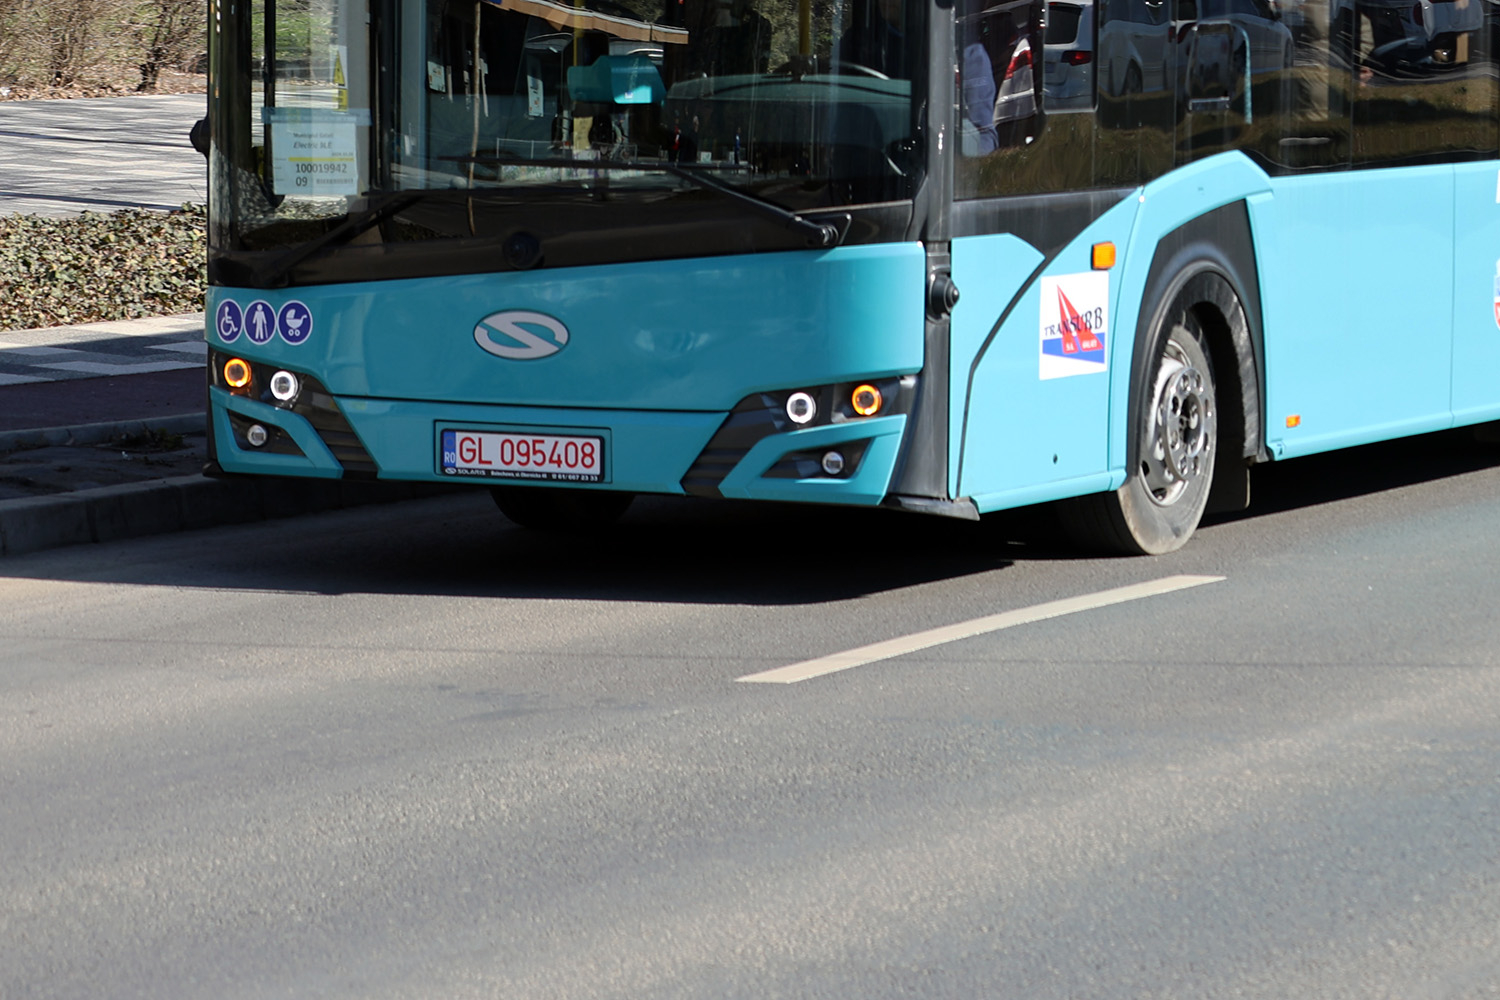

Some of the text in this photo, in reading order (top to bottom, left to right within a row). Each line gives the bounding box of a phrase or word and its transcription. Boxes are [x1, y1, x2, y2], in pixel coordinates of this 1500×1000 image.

[295, 163, 347, 174] 100019942
[295, 176, 308, 187] 09
[1044, 306, 1104, 337] TRANSURB
[444, 451, 456, 464] RO
[459, 436, 596, 469] GL 095408
